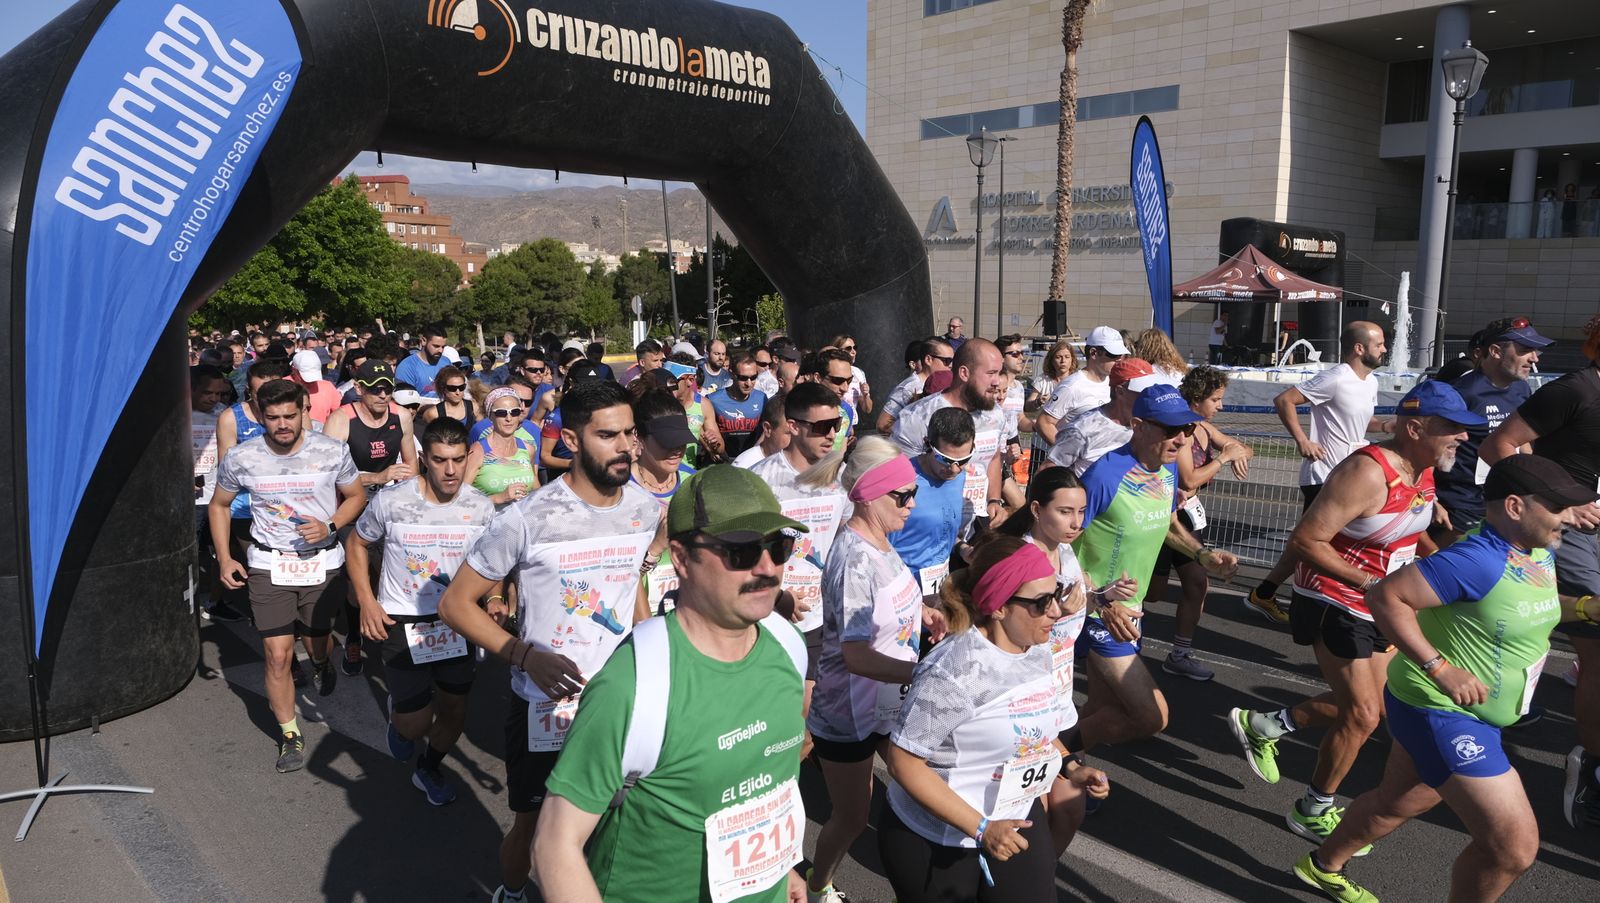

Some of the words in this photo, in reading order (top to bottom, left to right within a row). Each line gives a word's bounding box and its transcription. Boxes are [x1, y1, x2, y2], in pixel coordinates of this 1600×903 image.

[526, 8, 771, 88] cruzandolameta
[613, 68, 708, 97] cronometraje
[711, 83, 771, 106] deportivo
[168, 70, 292, 263] centrohogarsanchez.es
[370, 441, 386, 450] YES
[278, 561, 321, 574] 1037
[568, 549, 602, 562] CARRERA
[617, 546, 637, 555] HUMO
[415, 631, 458, 649] 1041
[721, 786, 737, 804] El
[739, 773, 772, 797] Ejido
[1021, 762, 1048, 789] 94
[727, 805, 766, 827] CARRERA
[767, 798, 779, 811] SIN
[724, 813, 796, 868] 1211
